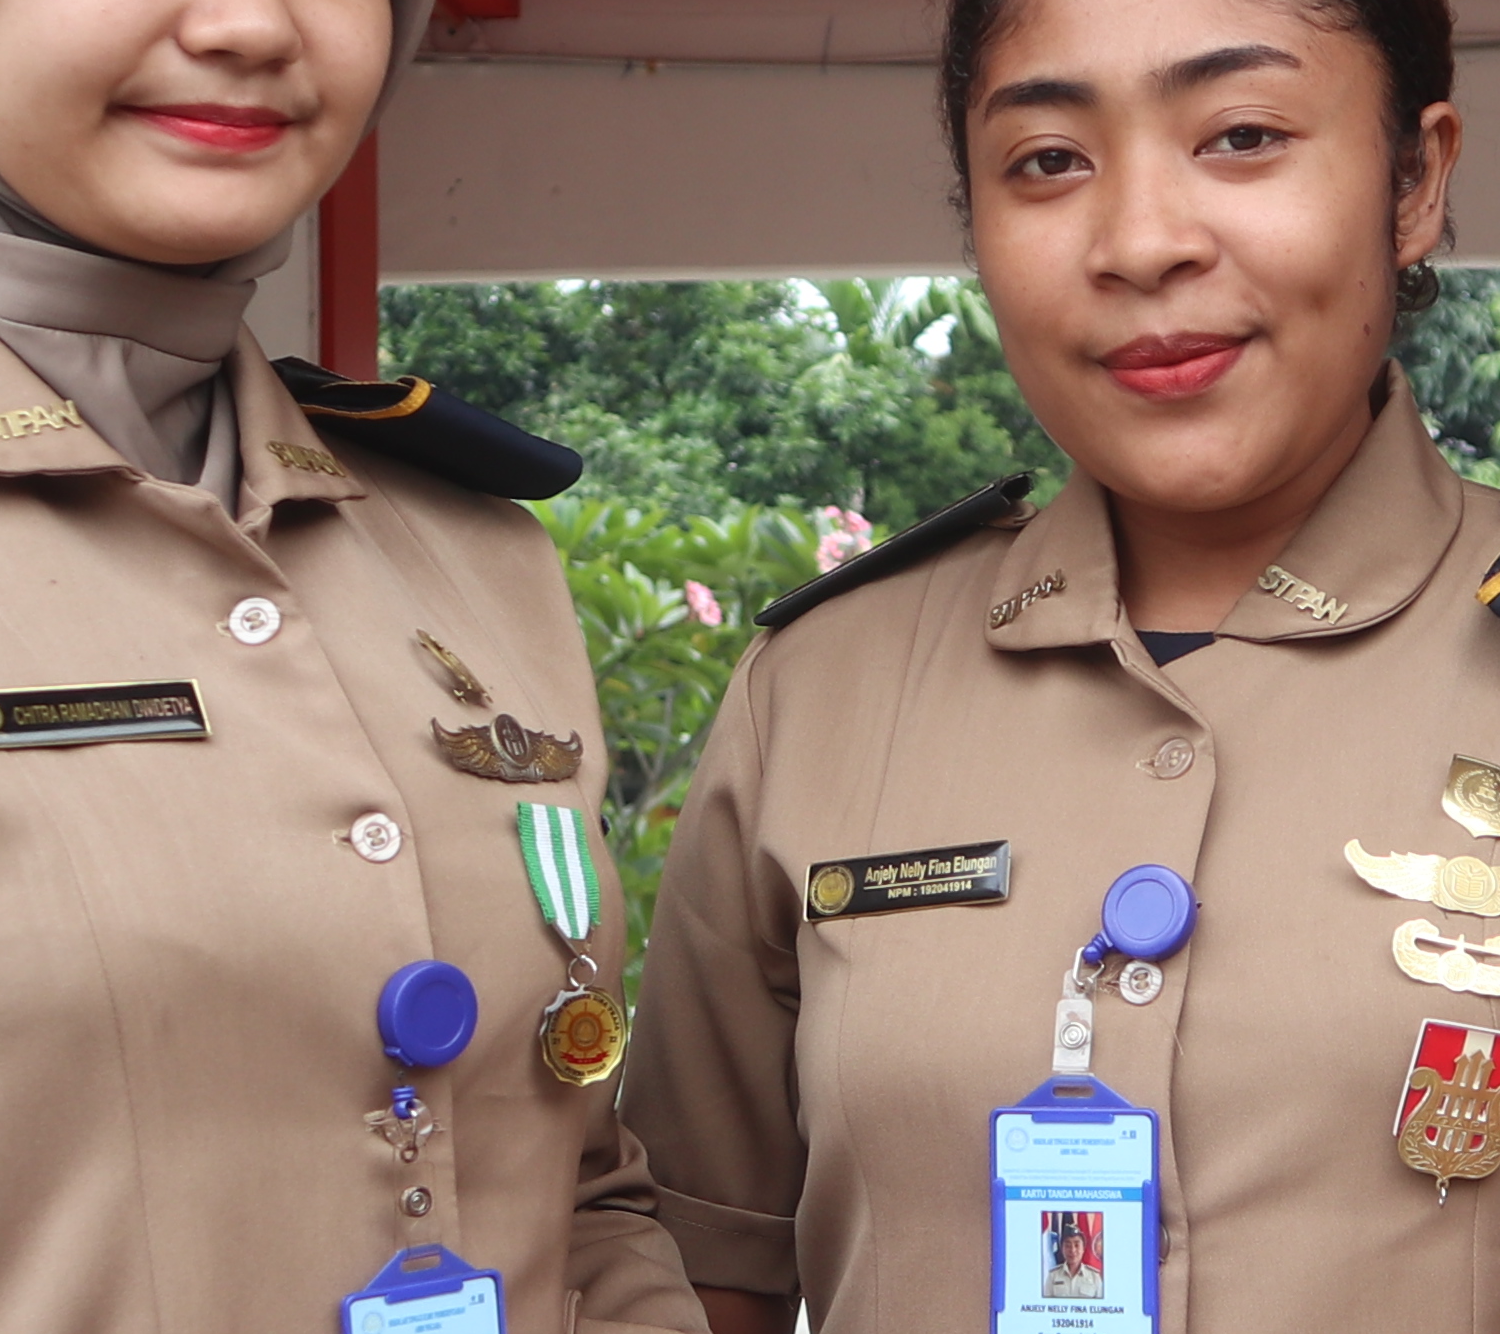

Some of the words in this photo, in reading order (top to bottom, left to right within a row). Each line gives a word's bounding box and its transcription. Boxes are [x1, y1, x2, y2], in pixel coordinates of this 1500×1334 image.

[1258, 565, 1349, 625] STIPAN
[864, 864, 898, 886] Anjely
[899, 861, 927, 881] Nelly
[928, 859, 952, 876] Fina
[953, 855, 998, 875] Elungan
[887, 887, 912, 899] NPM
[920, 879, 973, 896] 192041914
[1021, 1188, 1047, 1199] KARTU
[1047, 1188, 1074, 1200] TANDA
[1074, 1189, 1123, 1200] MAHASISWA
[1051, 1318, 1094, 1328] 192041914
